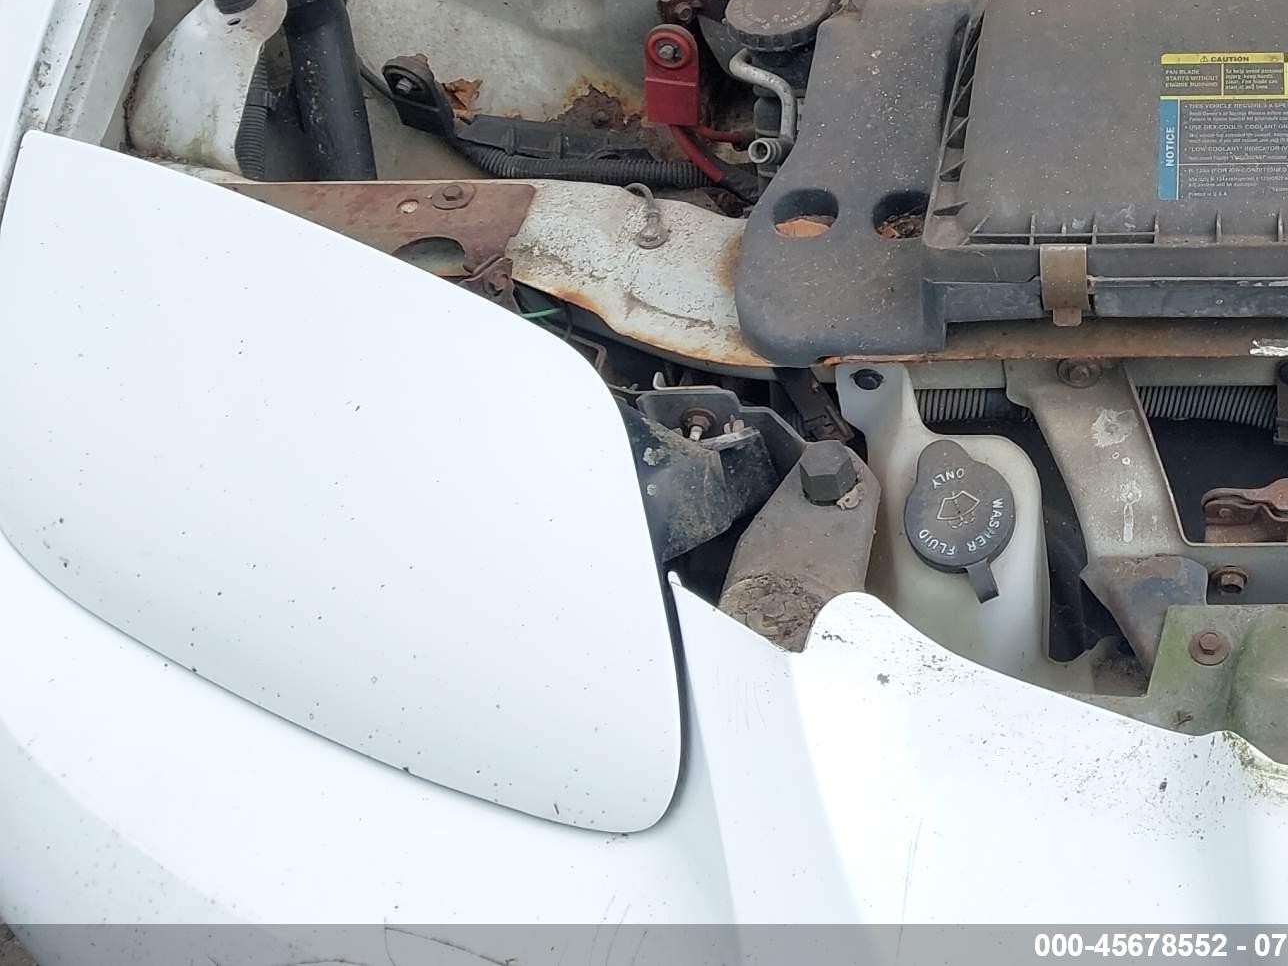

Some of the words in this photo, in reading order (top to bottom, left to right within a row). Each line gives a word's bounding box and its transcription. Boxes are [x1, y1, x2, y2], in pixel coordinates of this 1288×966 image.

[1165, 127, 1175, 167] NOTICE
[931, 467, 965, 489] ONLY
[966, 498, 1004, 553] WASHER
[918, 529, 957, 556] FLUID
